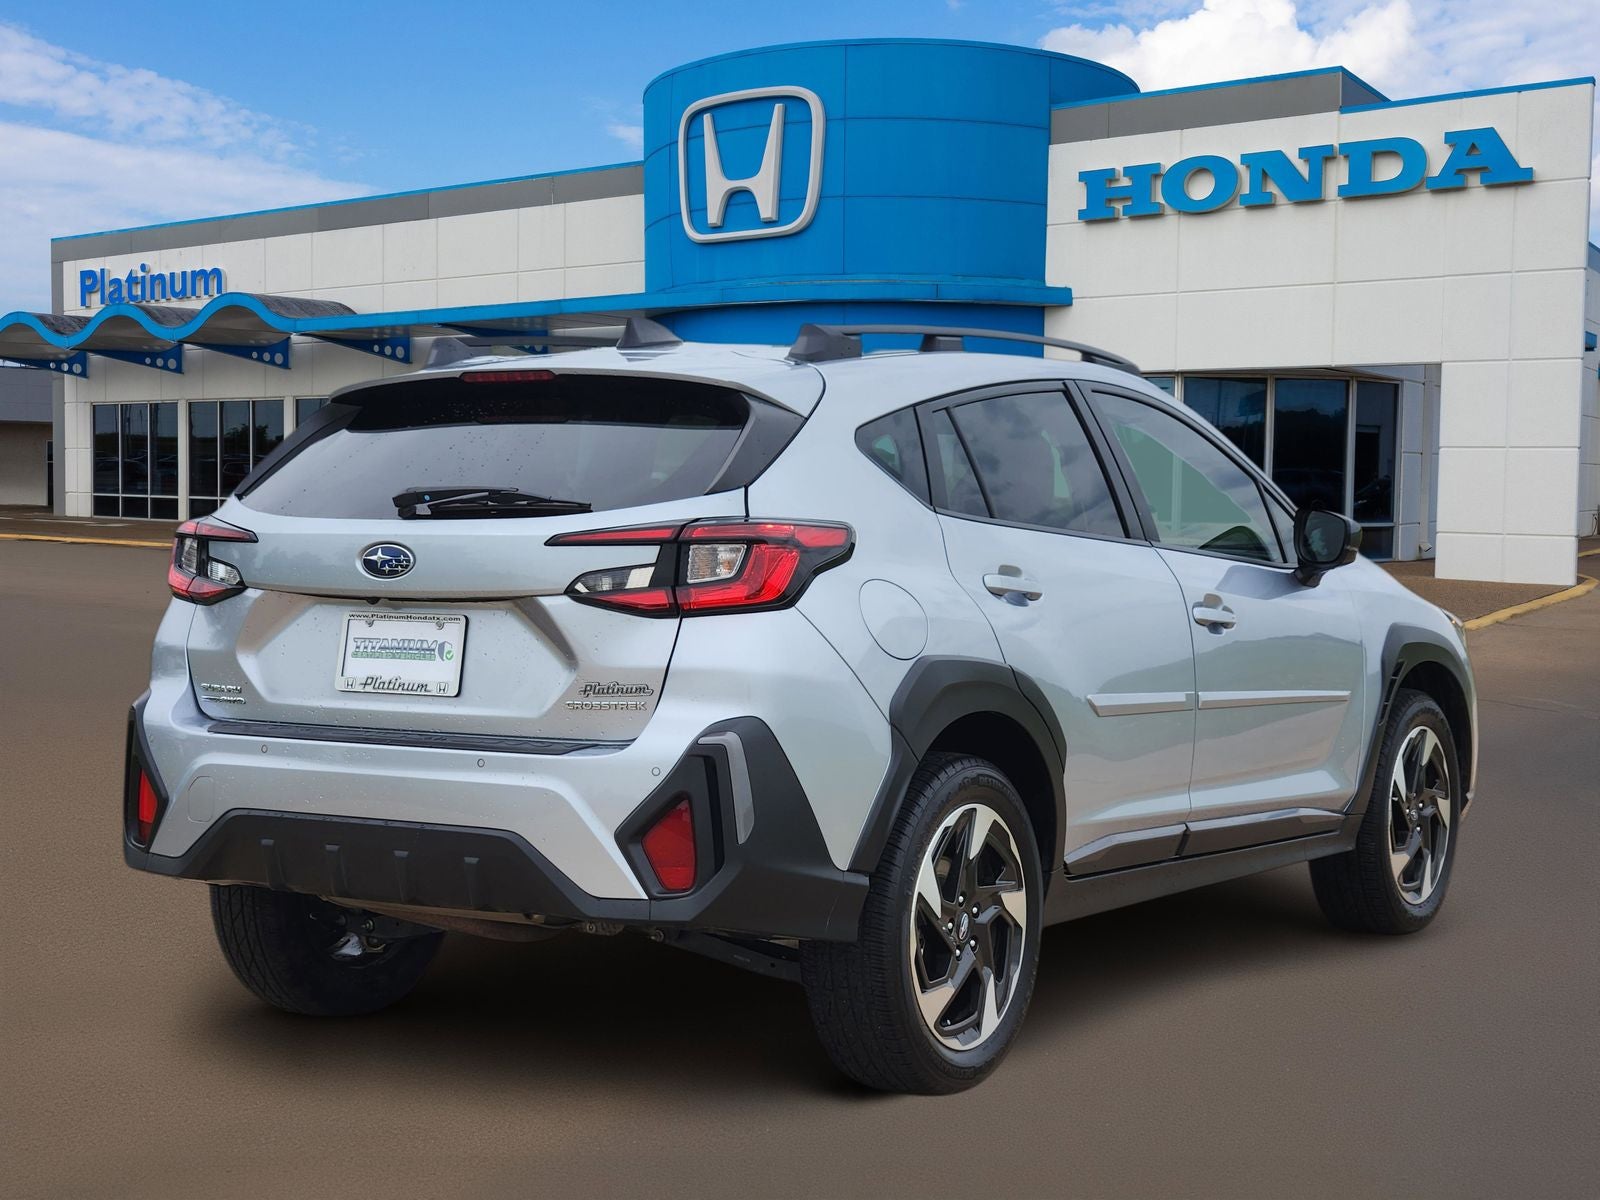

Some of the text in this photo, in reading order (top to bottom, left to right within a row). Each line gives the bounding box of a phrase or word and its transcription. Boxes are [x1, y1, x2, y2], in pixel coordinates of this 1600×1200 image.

[1078, 126, 1534, 222] HONDA
[79, 263, 227, 308] Platinum
[353, 637, 438, 653] TITANIUM
[359, 675, 433, 693] Platinum
[579, 681, 654, 698] Platinum
[565, 701, 648, 711] CROSSTREK
